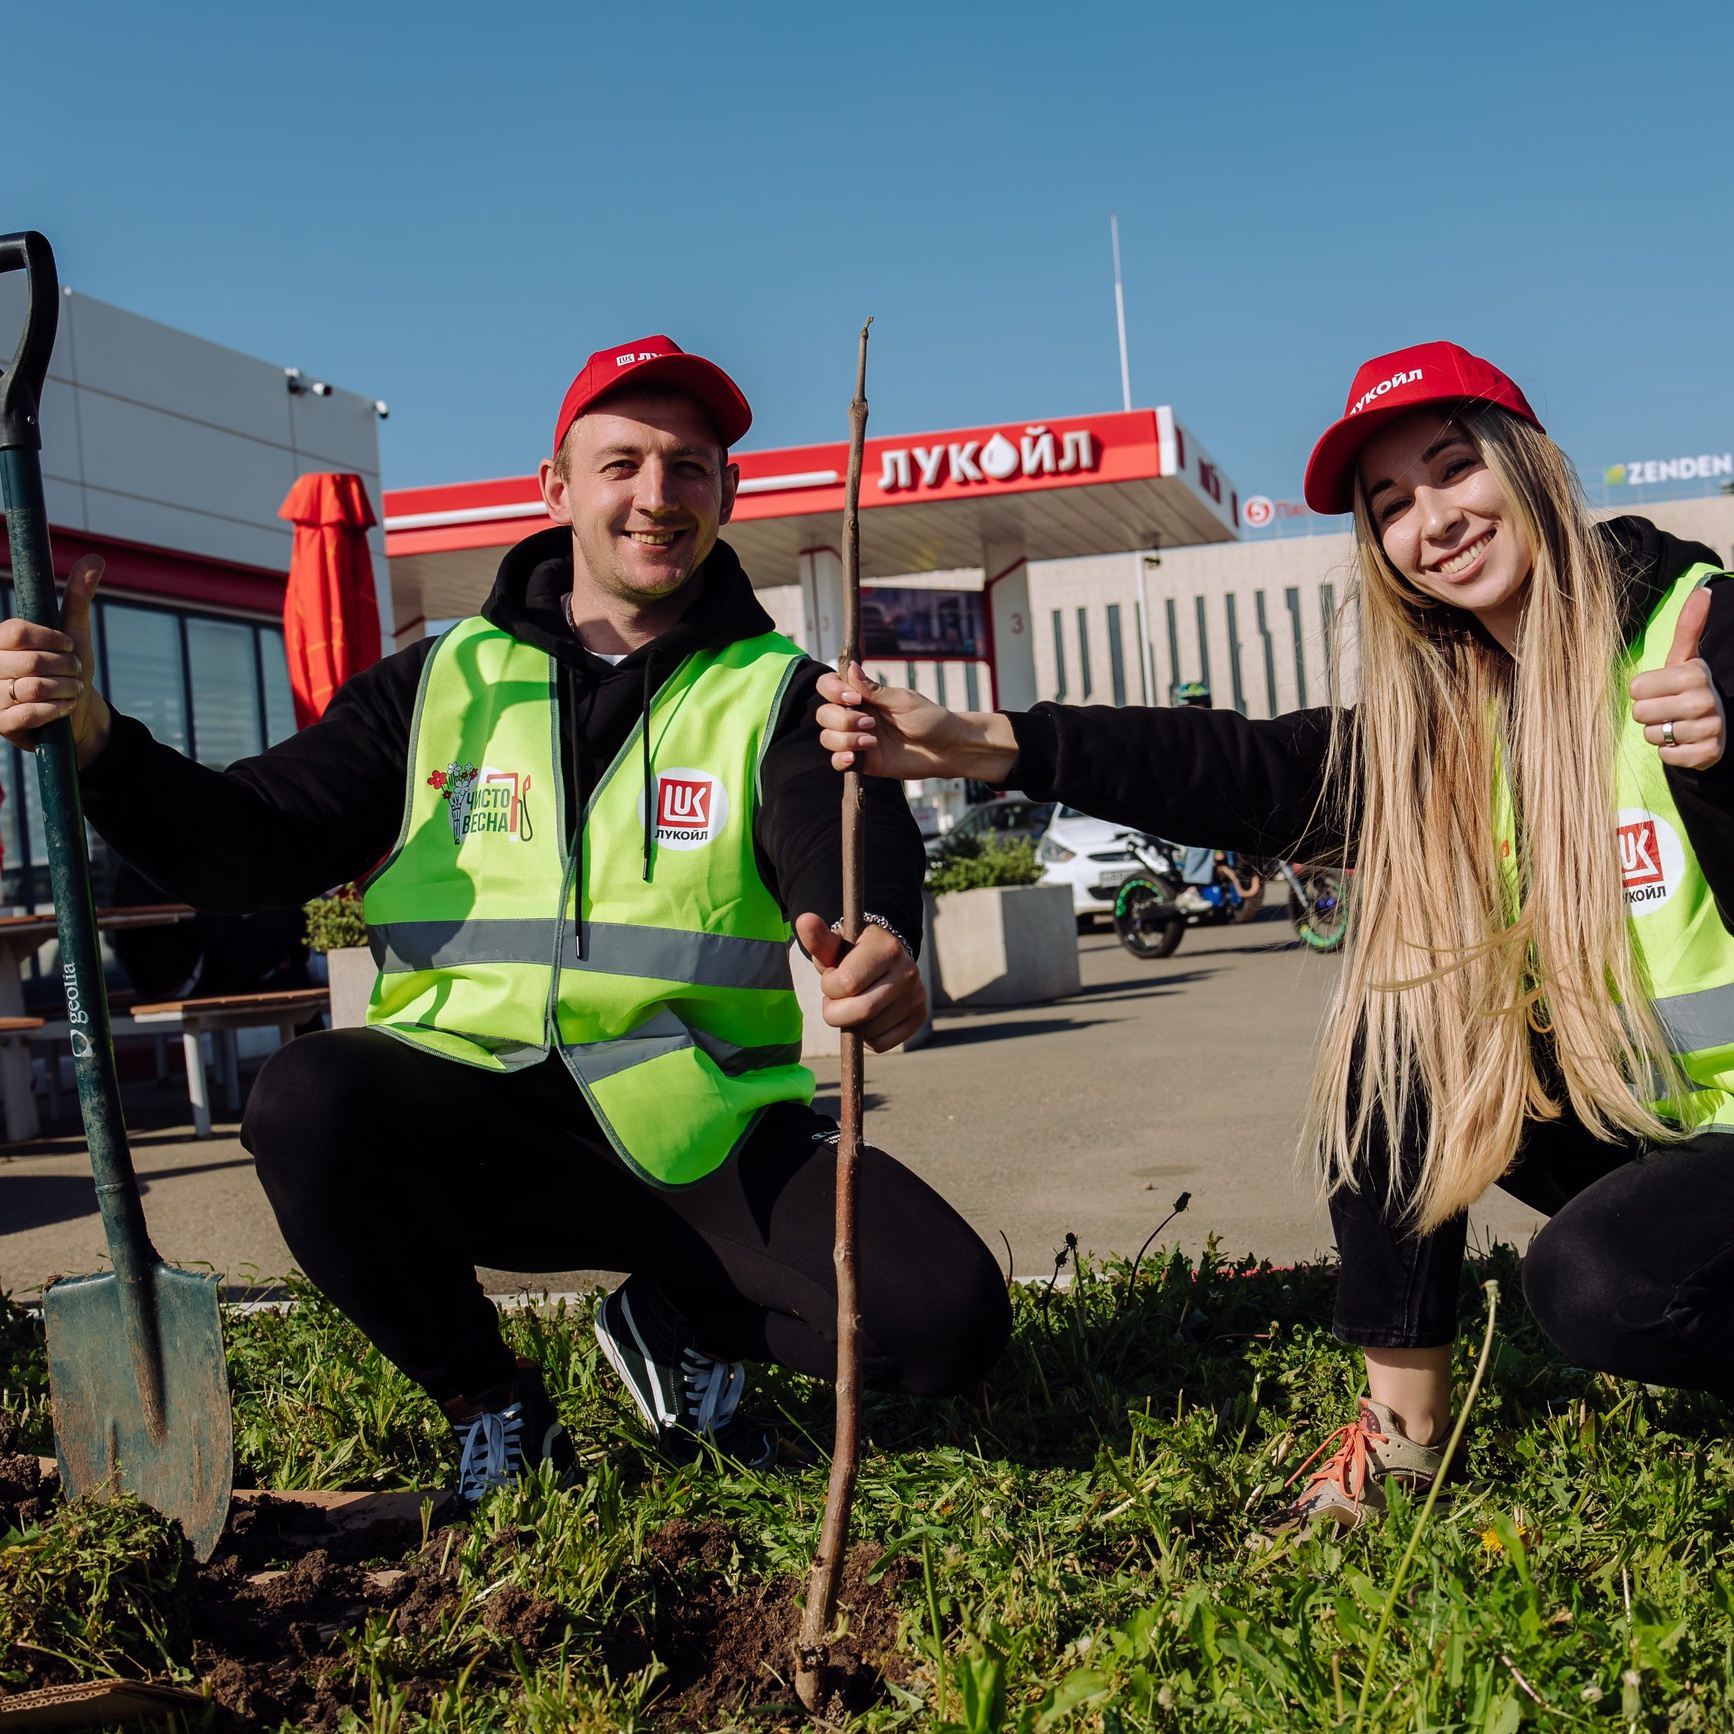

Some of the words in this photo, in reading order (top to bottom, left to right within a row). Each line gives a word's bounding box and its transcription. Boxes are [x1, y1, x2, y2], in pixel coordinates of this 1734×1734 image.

[878, 425, 1094, 491] ЛУКОЙЛ
[1627, 453, 1733, 486] ZENDEN
[1010, 611, 1025, 636] 3
[467, 788, 511, 811] ЧИСТО
[462, 812, 508, 835] ВЕСНА
[655, 829, 709, 841] ЛУКОЙЛ
[1619, 828, 1660, 880] UK
[63, 960, 90, 1025] geolia
